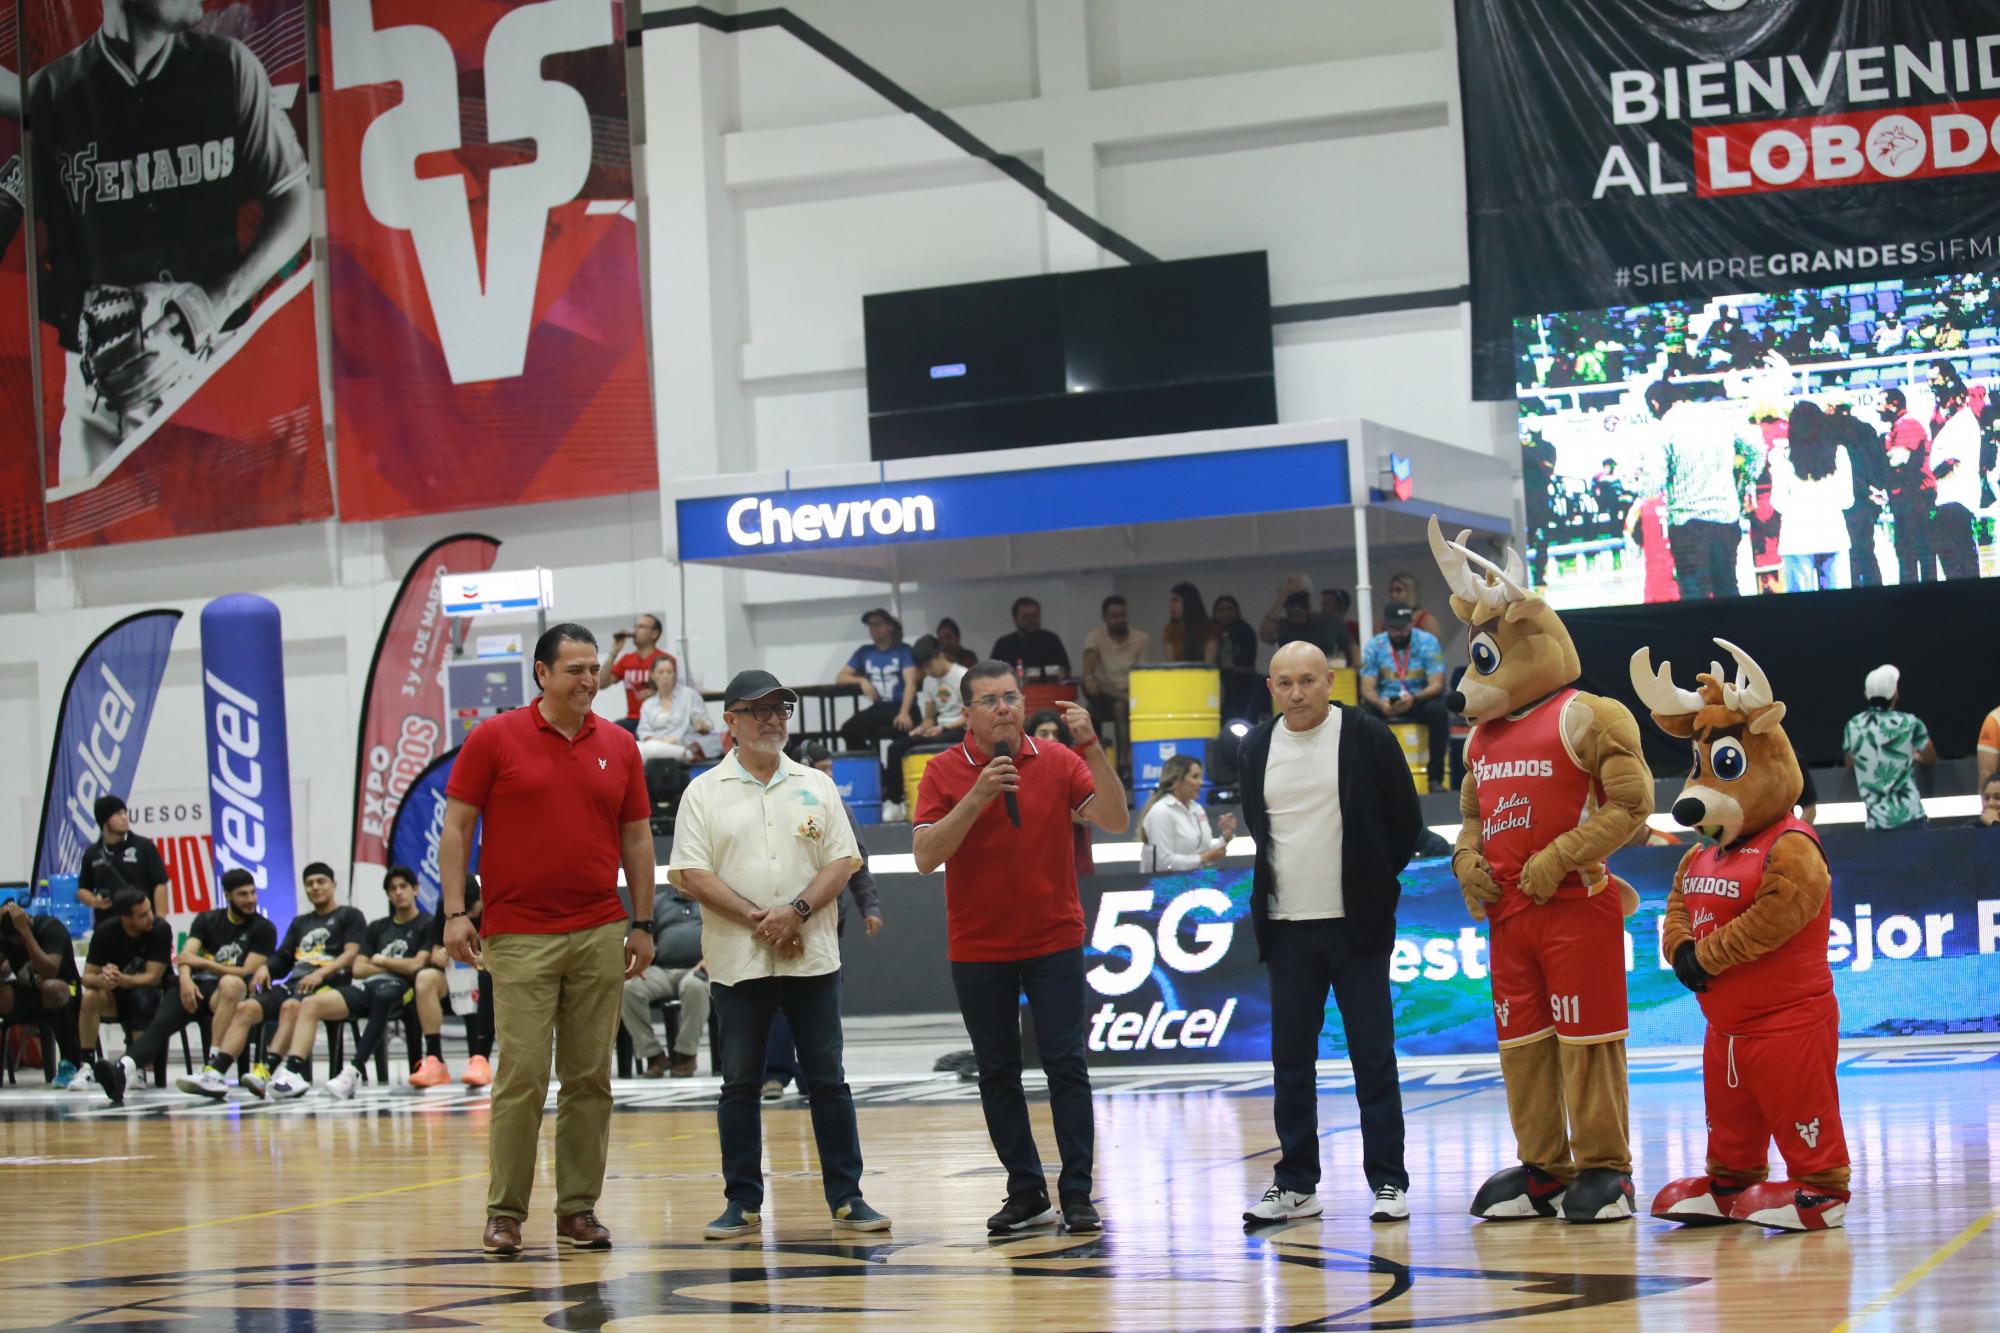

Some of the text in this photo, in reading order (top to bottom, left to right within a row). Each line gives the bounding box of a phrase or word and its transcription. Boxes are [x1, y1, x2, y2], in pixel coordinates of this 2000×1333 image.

[1592, 112, 2000, 200] AL LOBOD
[1615, 234, 2000, 288] #SIEMPREGRANDESSIEM
[726, 494, 936, 547] Chevron
[412, 628, 432, 655] DE
[67, 662, 136, 843] telcel
[205, 668, 268, 890] telcel
[362, 745, 391, 838] EXPO
[1492, 792, 1529, 816] Salsa
[1481, 806, 1532, 842] Huichol
[1086, 887, 1234, 996] 5G
[1088, 997, 1238, 1051] telcel
[1550, 993, 1579, 1023] 911
